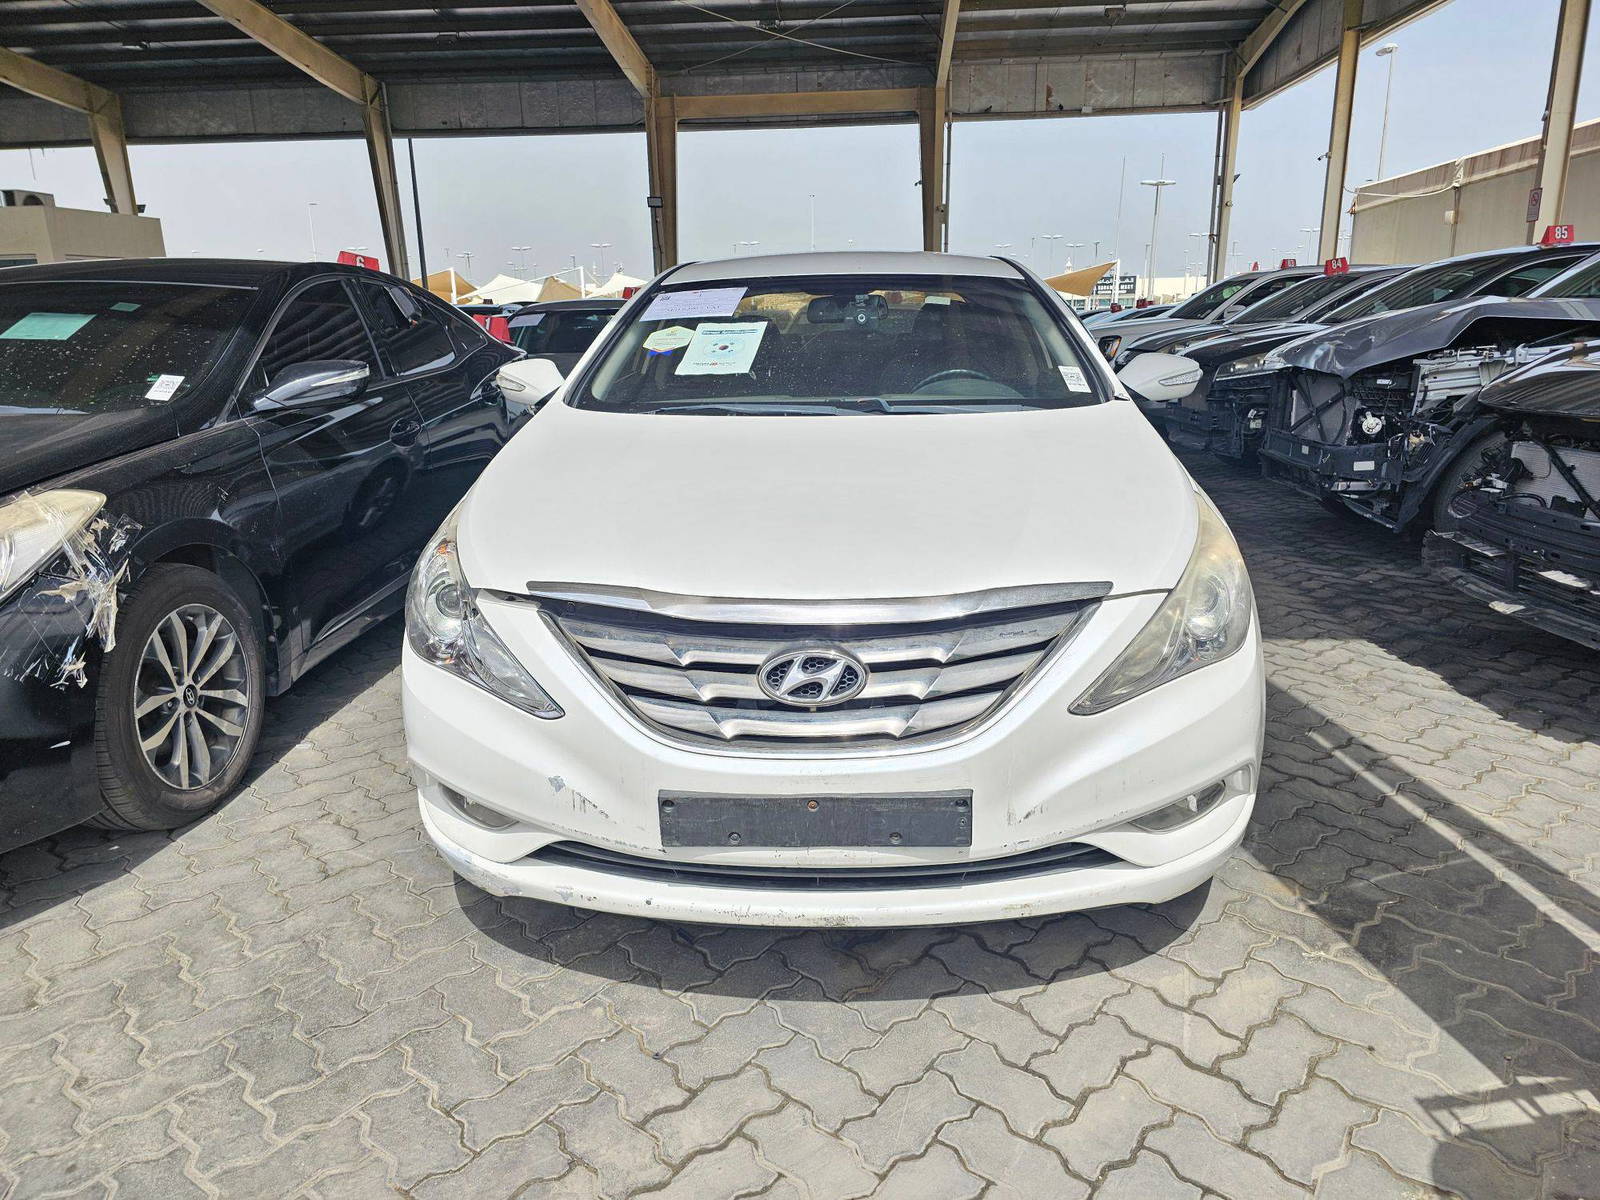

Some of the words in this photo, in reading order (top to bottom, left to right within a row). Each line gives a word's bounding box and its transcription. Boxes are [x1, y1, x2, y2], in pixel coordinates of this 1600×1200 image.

[1555, 225, 1568, 239] 85
[356, 256, 365, 268] 6
[1331, 259, 1342, 269] 84
